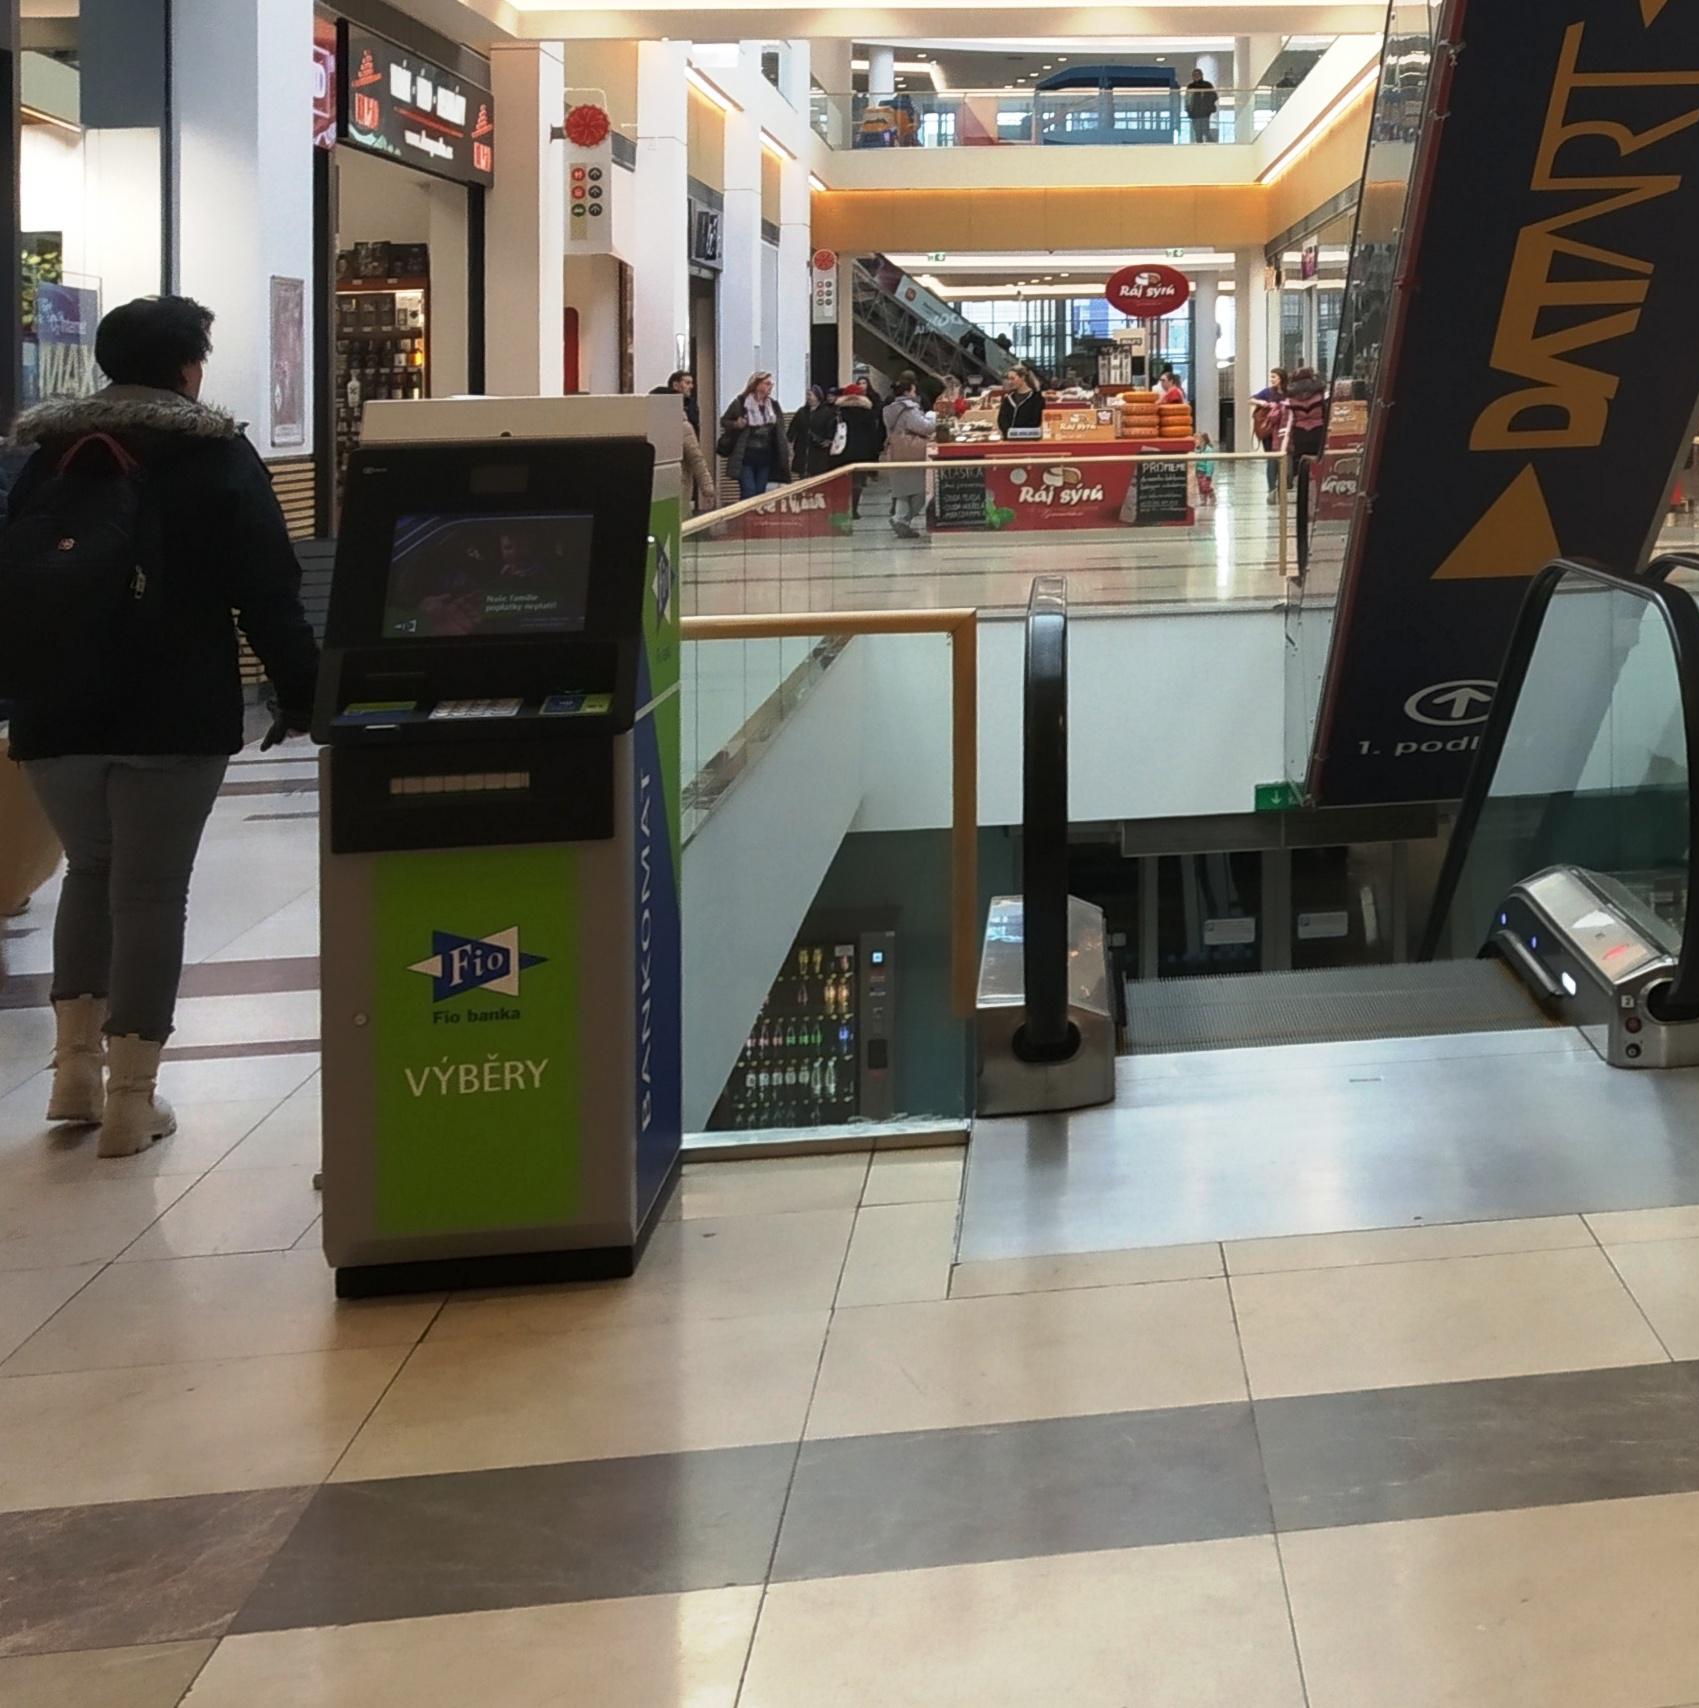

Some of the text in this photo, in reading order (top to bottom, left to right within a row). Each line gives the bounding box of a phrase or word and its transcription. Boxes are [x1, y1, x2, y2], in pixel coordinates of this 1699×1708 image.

[1119, 283, 1144, 298] Ráj
[1018, 485, 1054, 505] Ráj
[1358, 735, 1480, 757] 1. podl
[639, 767, 651, 1132] BANKOMAT
[450, 944, 504, 987] Fio
[432, 1008, 521, 1025] Fio banka
[404, 1052, 550, 1098] VÝBĚRY
